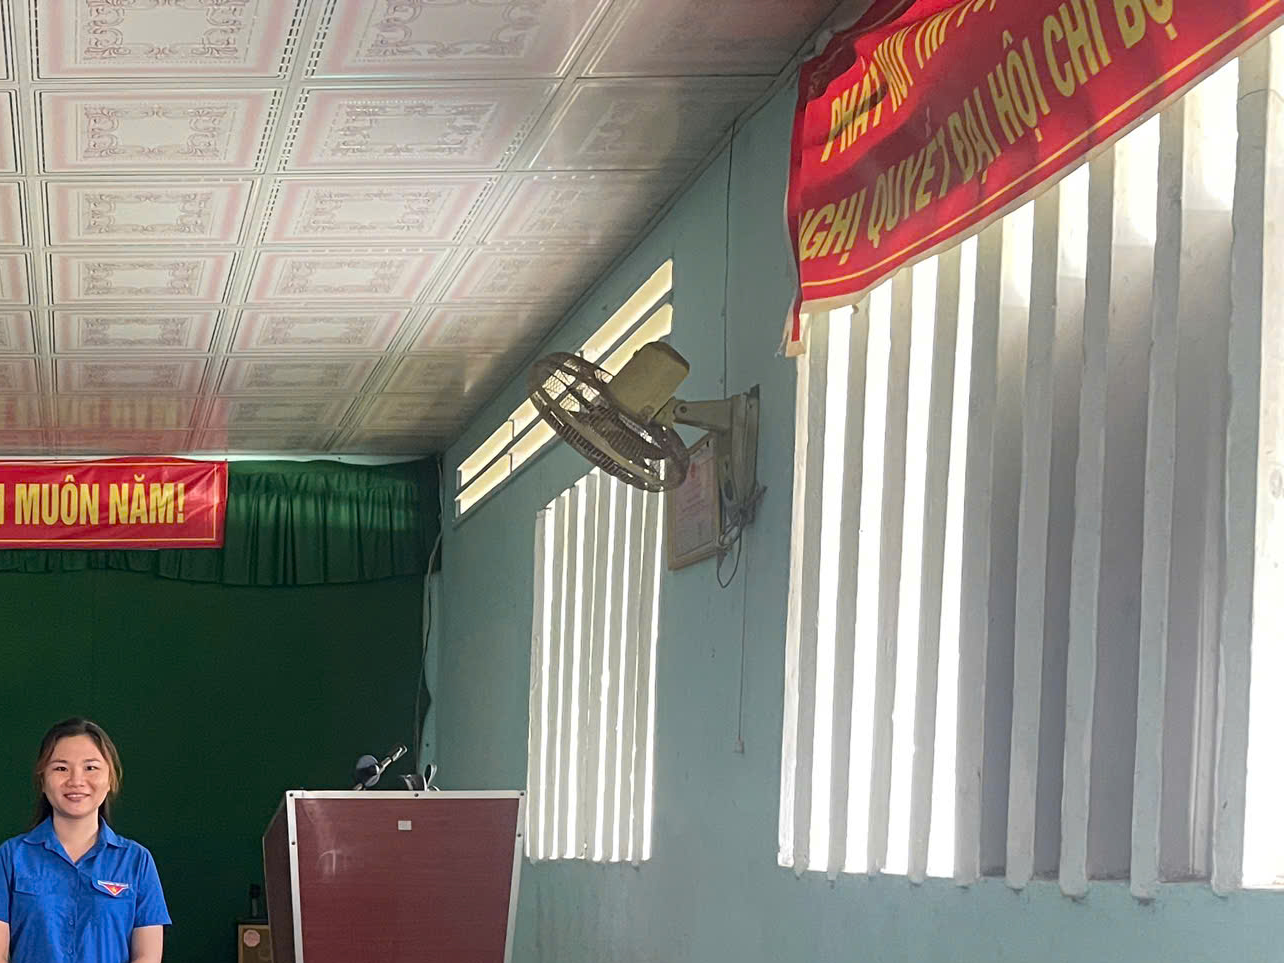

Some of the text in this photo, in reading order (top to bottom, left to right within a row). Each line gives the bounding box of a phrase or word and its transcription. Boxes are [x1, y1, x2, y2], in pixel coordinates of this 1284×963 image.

[868, 106, 951, 249] QUYẾT
[947, 87, 1002, 185] ĐẠI
[987, 30, 1051, 142] HỘI
[1042, 0, 1112, 97] CHI
[15, 474, 100, 526] MUÔN
[108, 473, 186, 525] NĂM!
